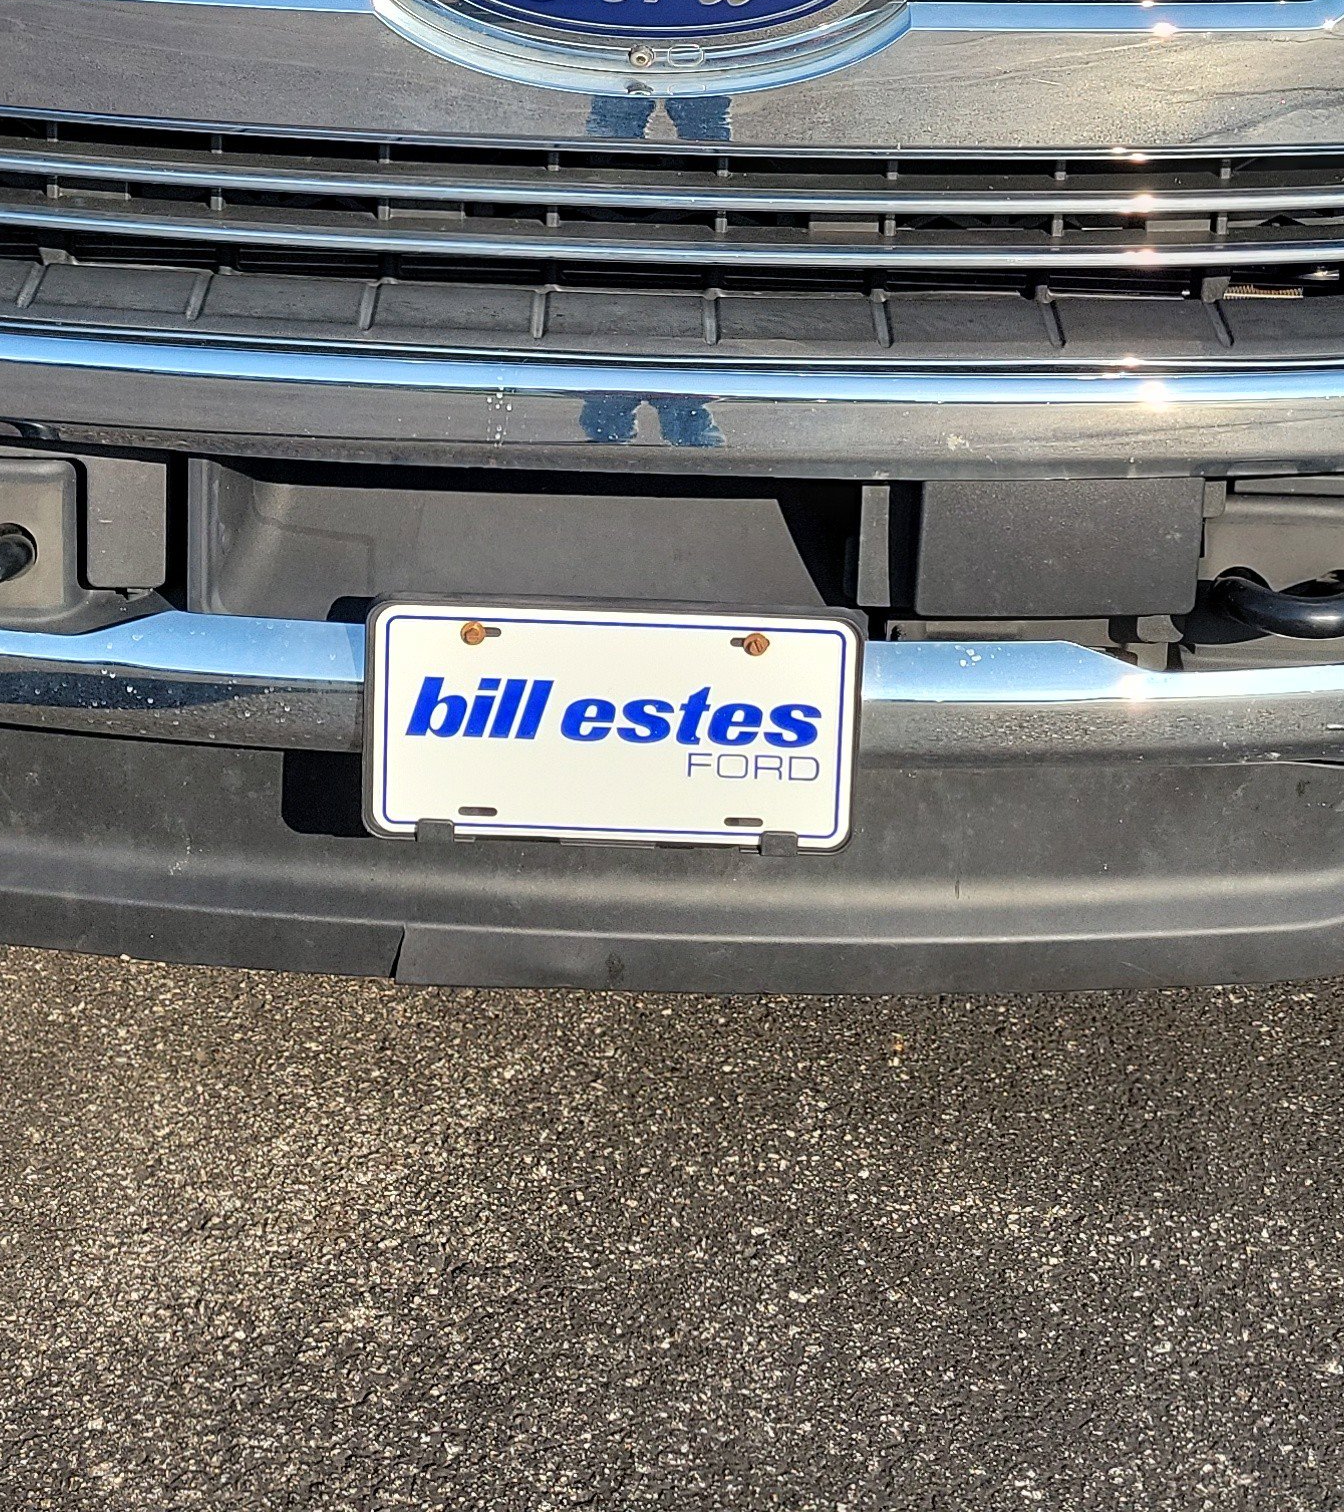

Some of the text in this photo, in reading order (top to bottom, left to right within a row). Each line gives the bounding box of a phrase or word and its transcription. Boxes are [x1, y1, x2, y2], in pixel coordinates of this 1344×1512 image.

[405, 676, 822, 749] bill estes
[687, 752, 821, 782] FORD
